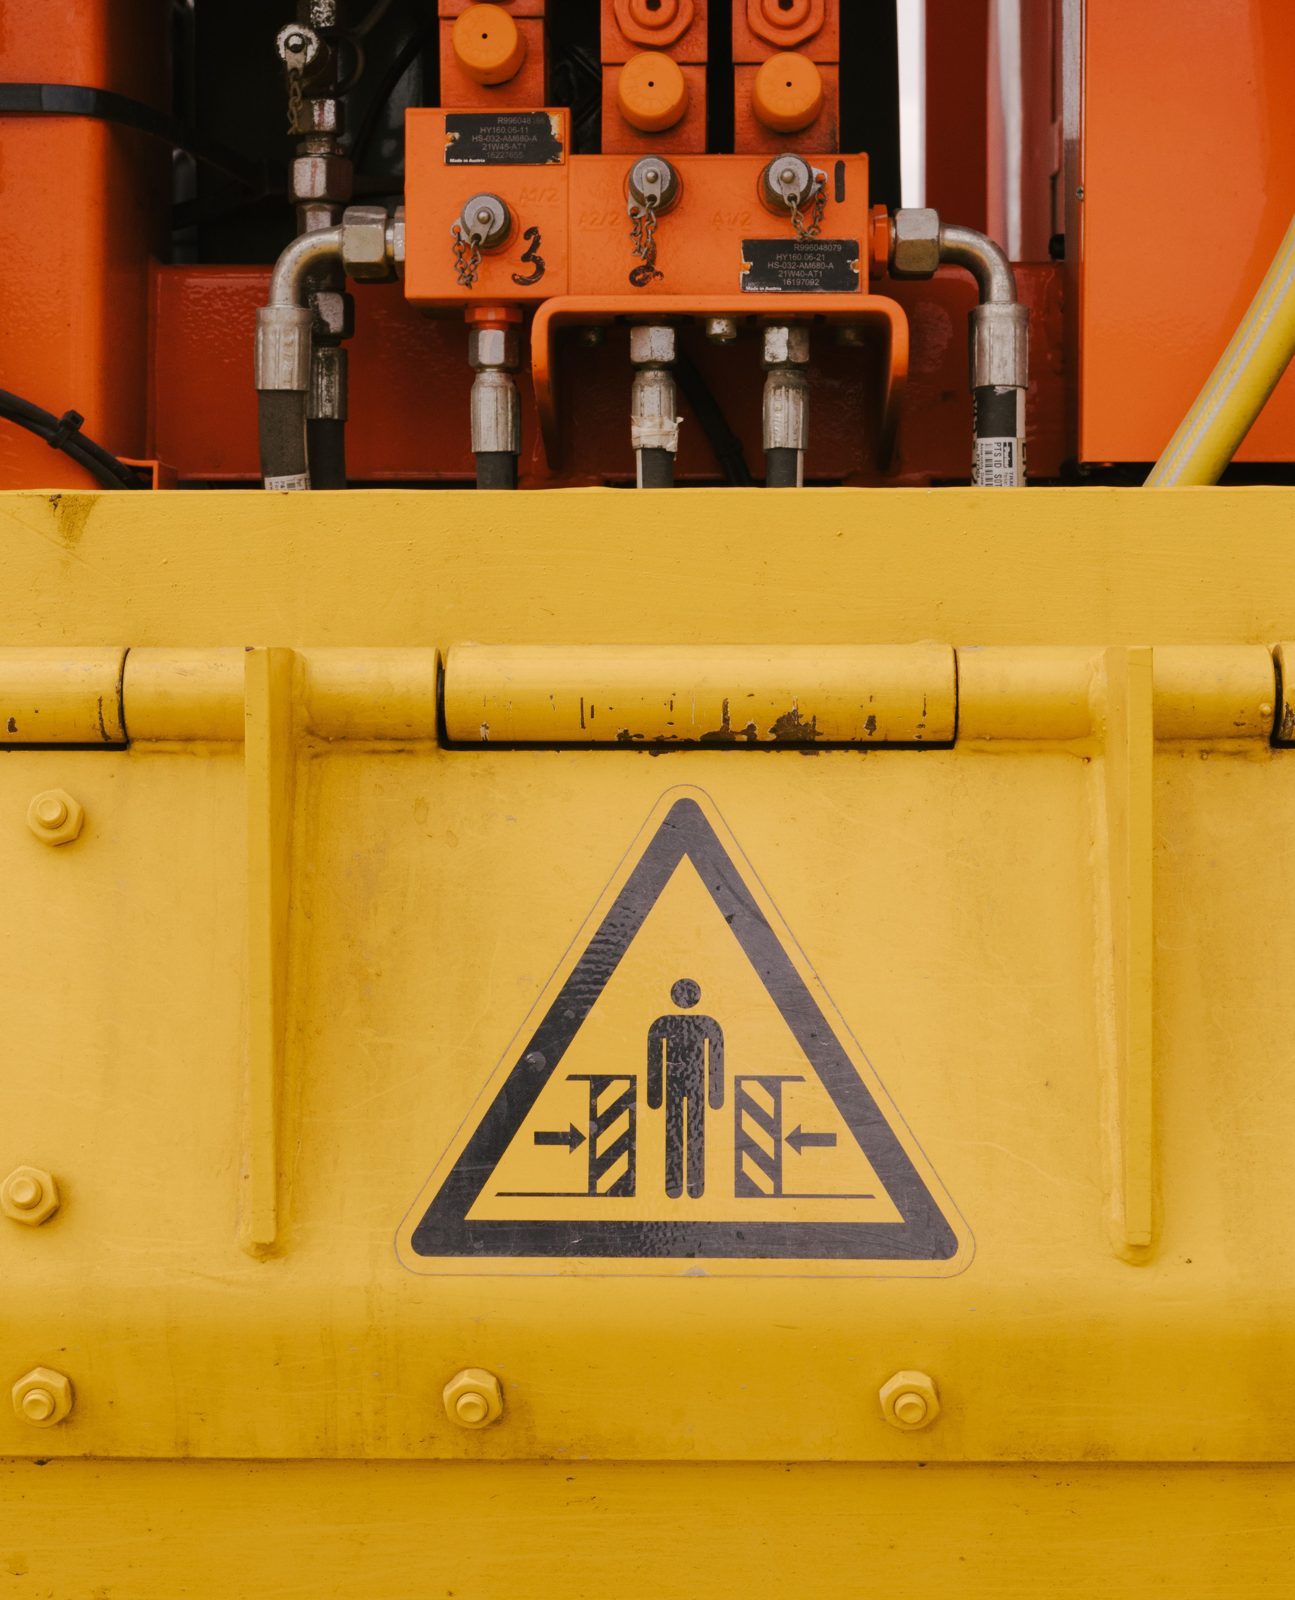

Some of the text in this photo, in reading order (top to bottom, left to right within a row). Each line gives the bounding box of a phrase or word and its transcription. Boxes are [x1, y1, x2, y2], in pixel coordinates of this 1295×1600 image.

[793, 243, 842, 252] R996048079
[511, 226, 546, 286] 3
[767, 261, 834, 269] HS-032-AM680-A
[778, 270, 823, 278] 21W40-AT1
[782, 278, 820, 286] 16197092
[993, 442, 1002, 457] PTS
[993, 460, 1002, 469] ID
